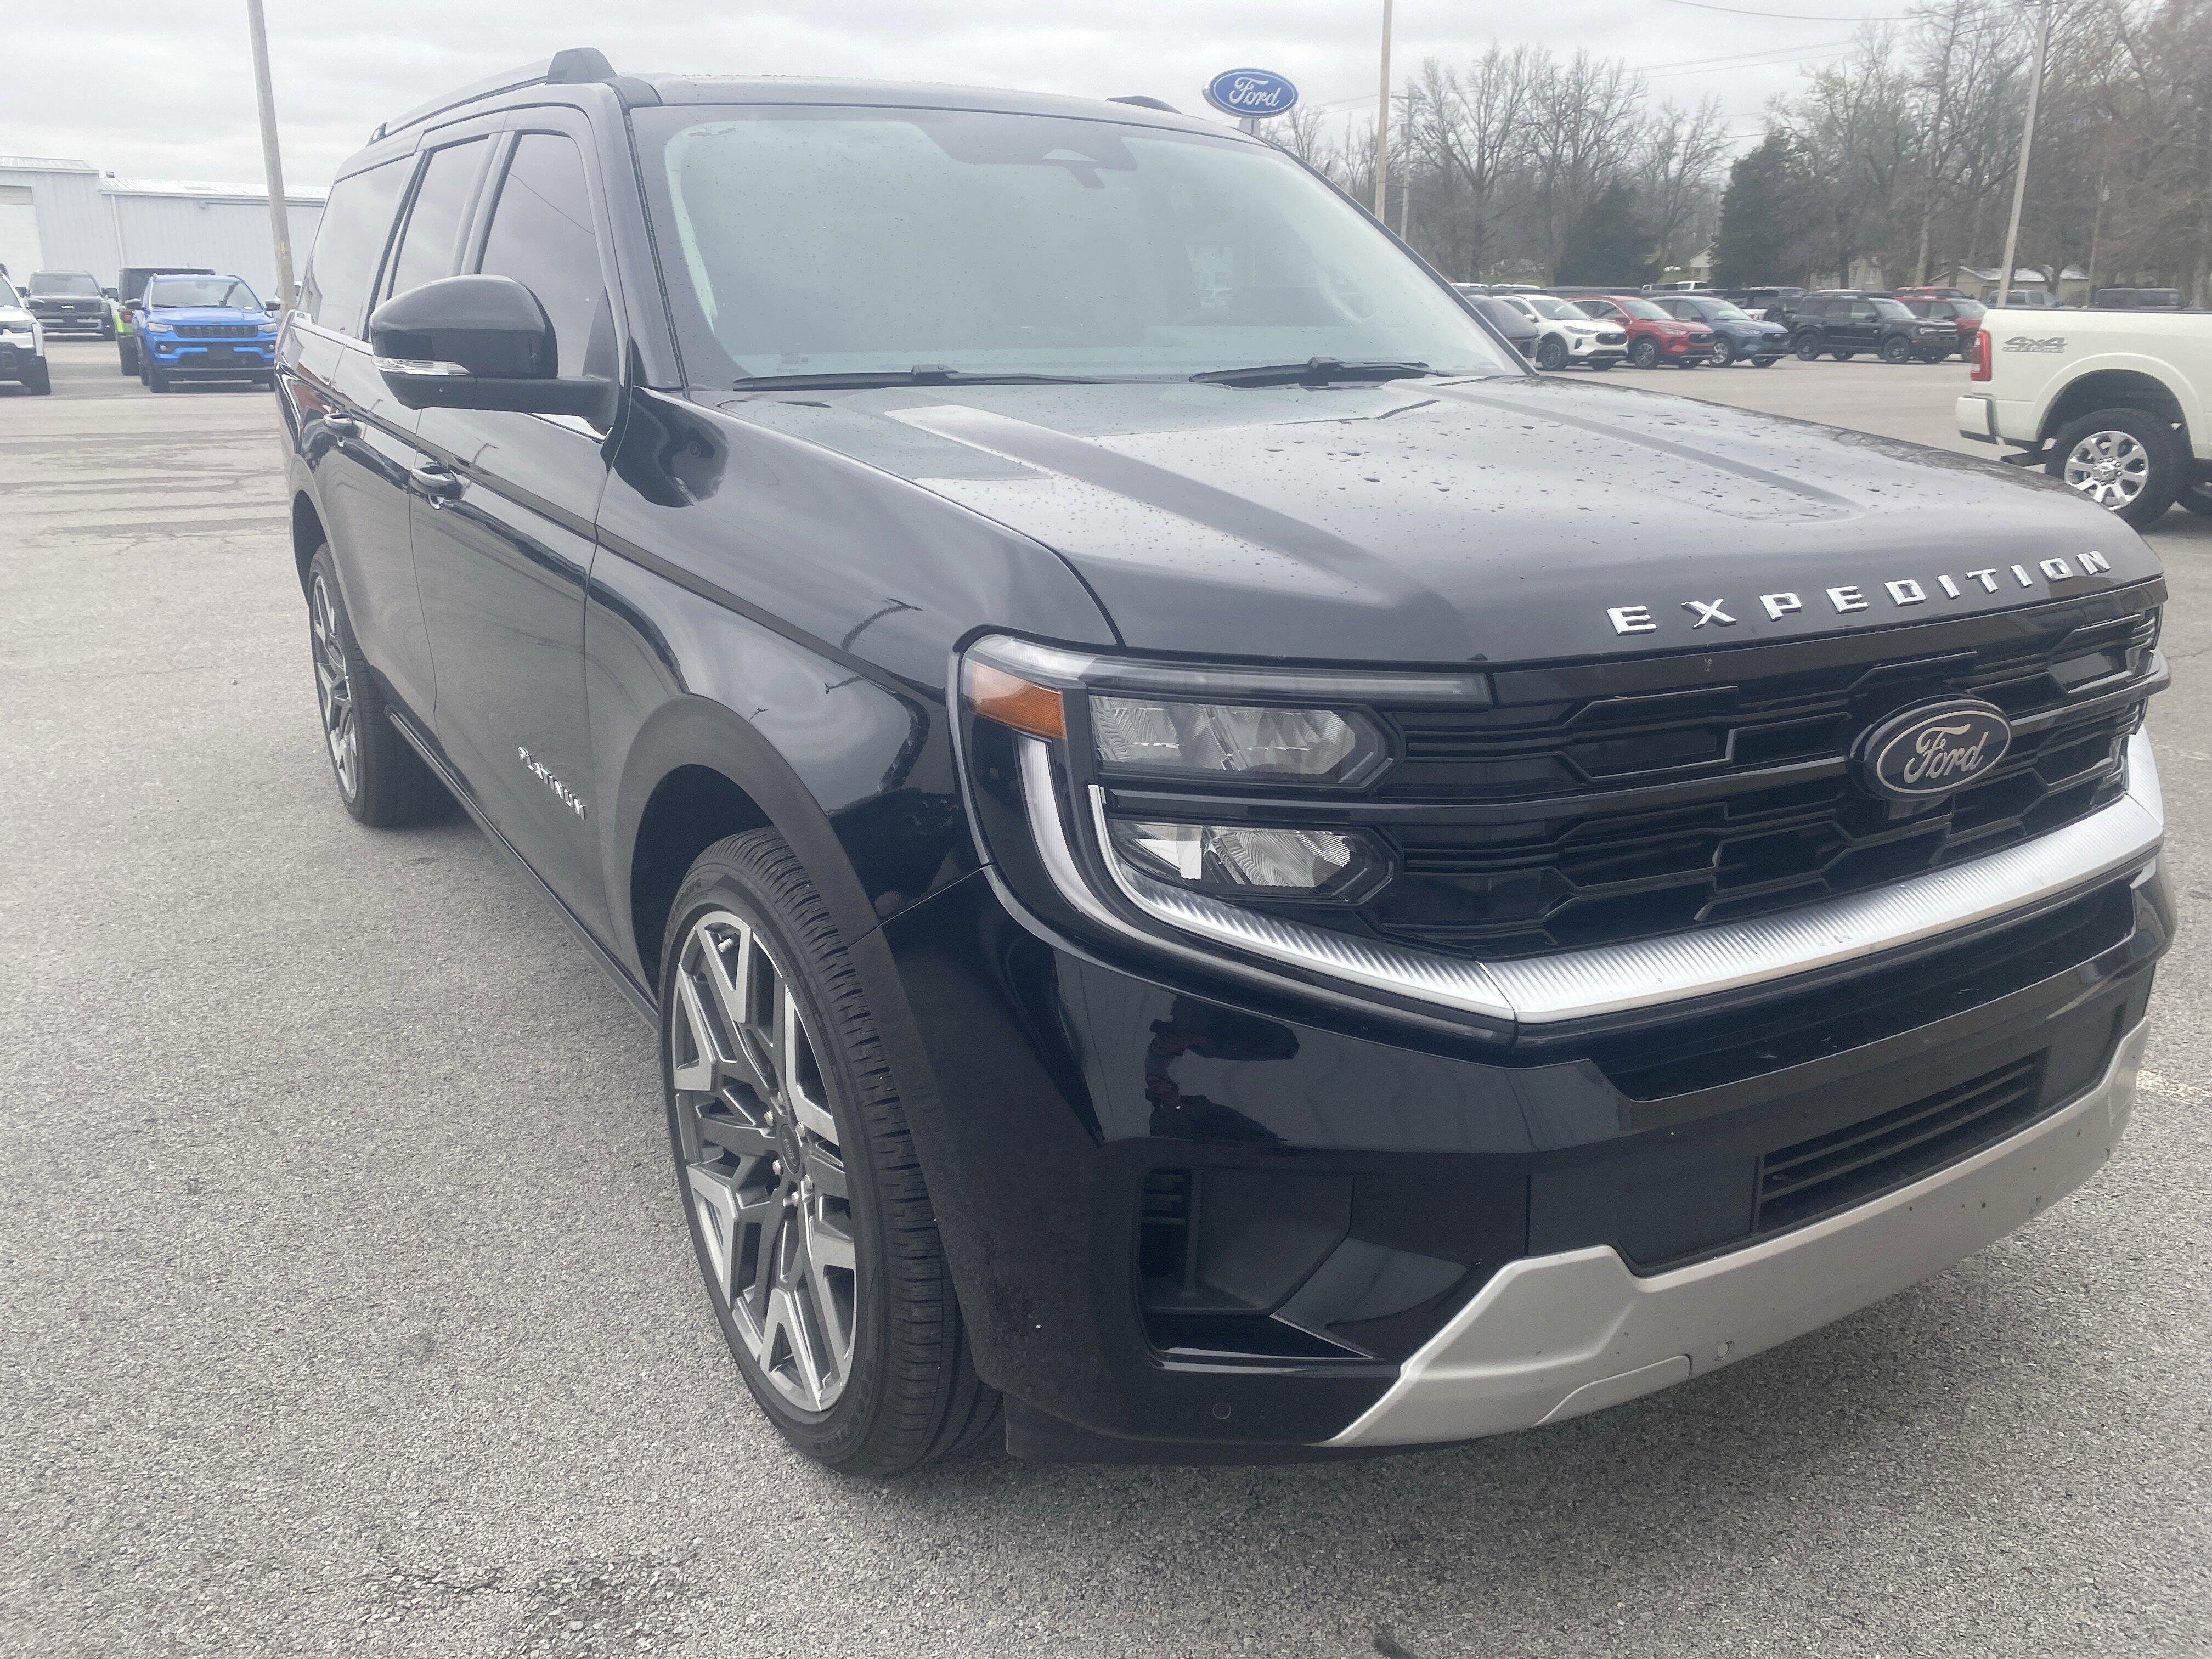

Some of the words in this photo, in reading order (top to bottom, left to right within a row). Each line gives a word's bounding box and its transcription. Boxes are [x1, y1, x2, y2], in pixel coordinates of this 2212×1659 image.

[1228, 76, 1282, 107] Ford
[2004, 336, 2068, 348] 4x4
[1606, 550, 2112, 635] EXPEDITION
[1903, 723, 1989, 783] Ford
[518, 747, 586, 821] PLATINUM
